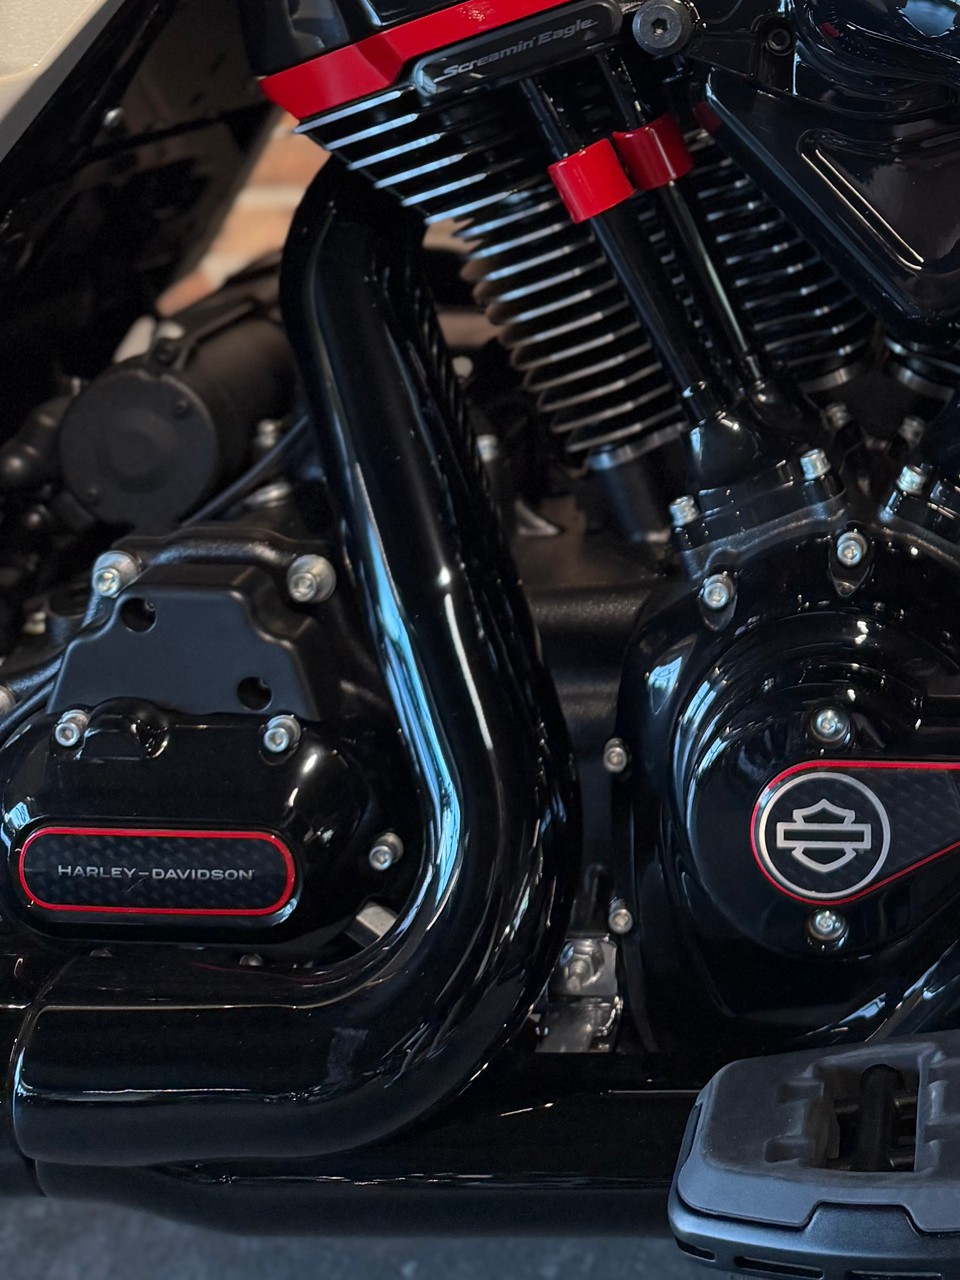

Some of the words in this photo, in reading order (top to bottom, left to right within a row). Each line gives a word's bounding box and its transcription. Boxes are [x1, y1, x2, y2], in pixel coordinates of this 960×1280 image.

[434, 35, 536, 82] Screamin'
[537, 18, 599, 46] Eagle
[57, 865, 254, 881] HARLEY-DAVIDSON
